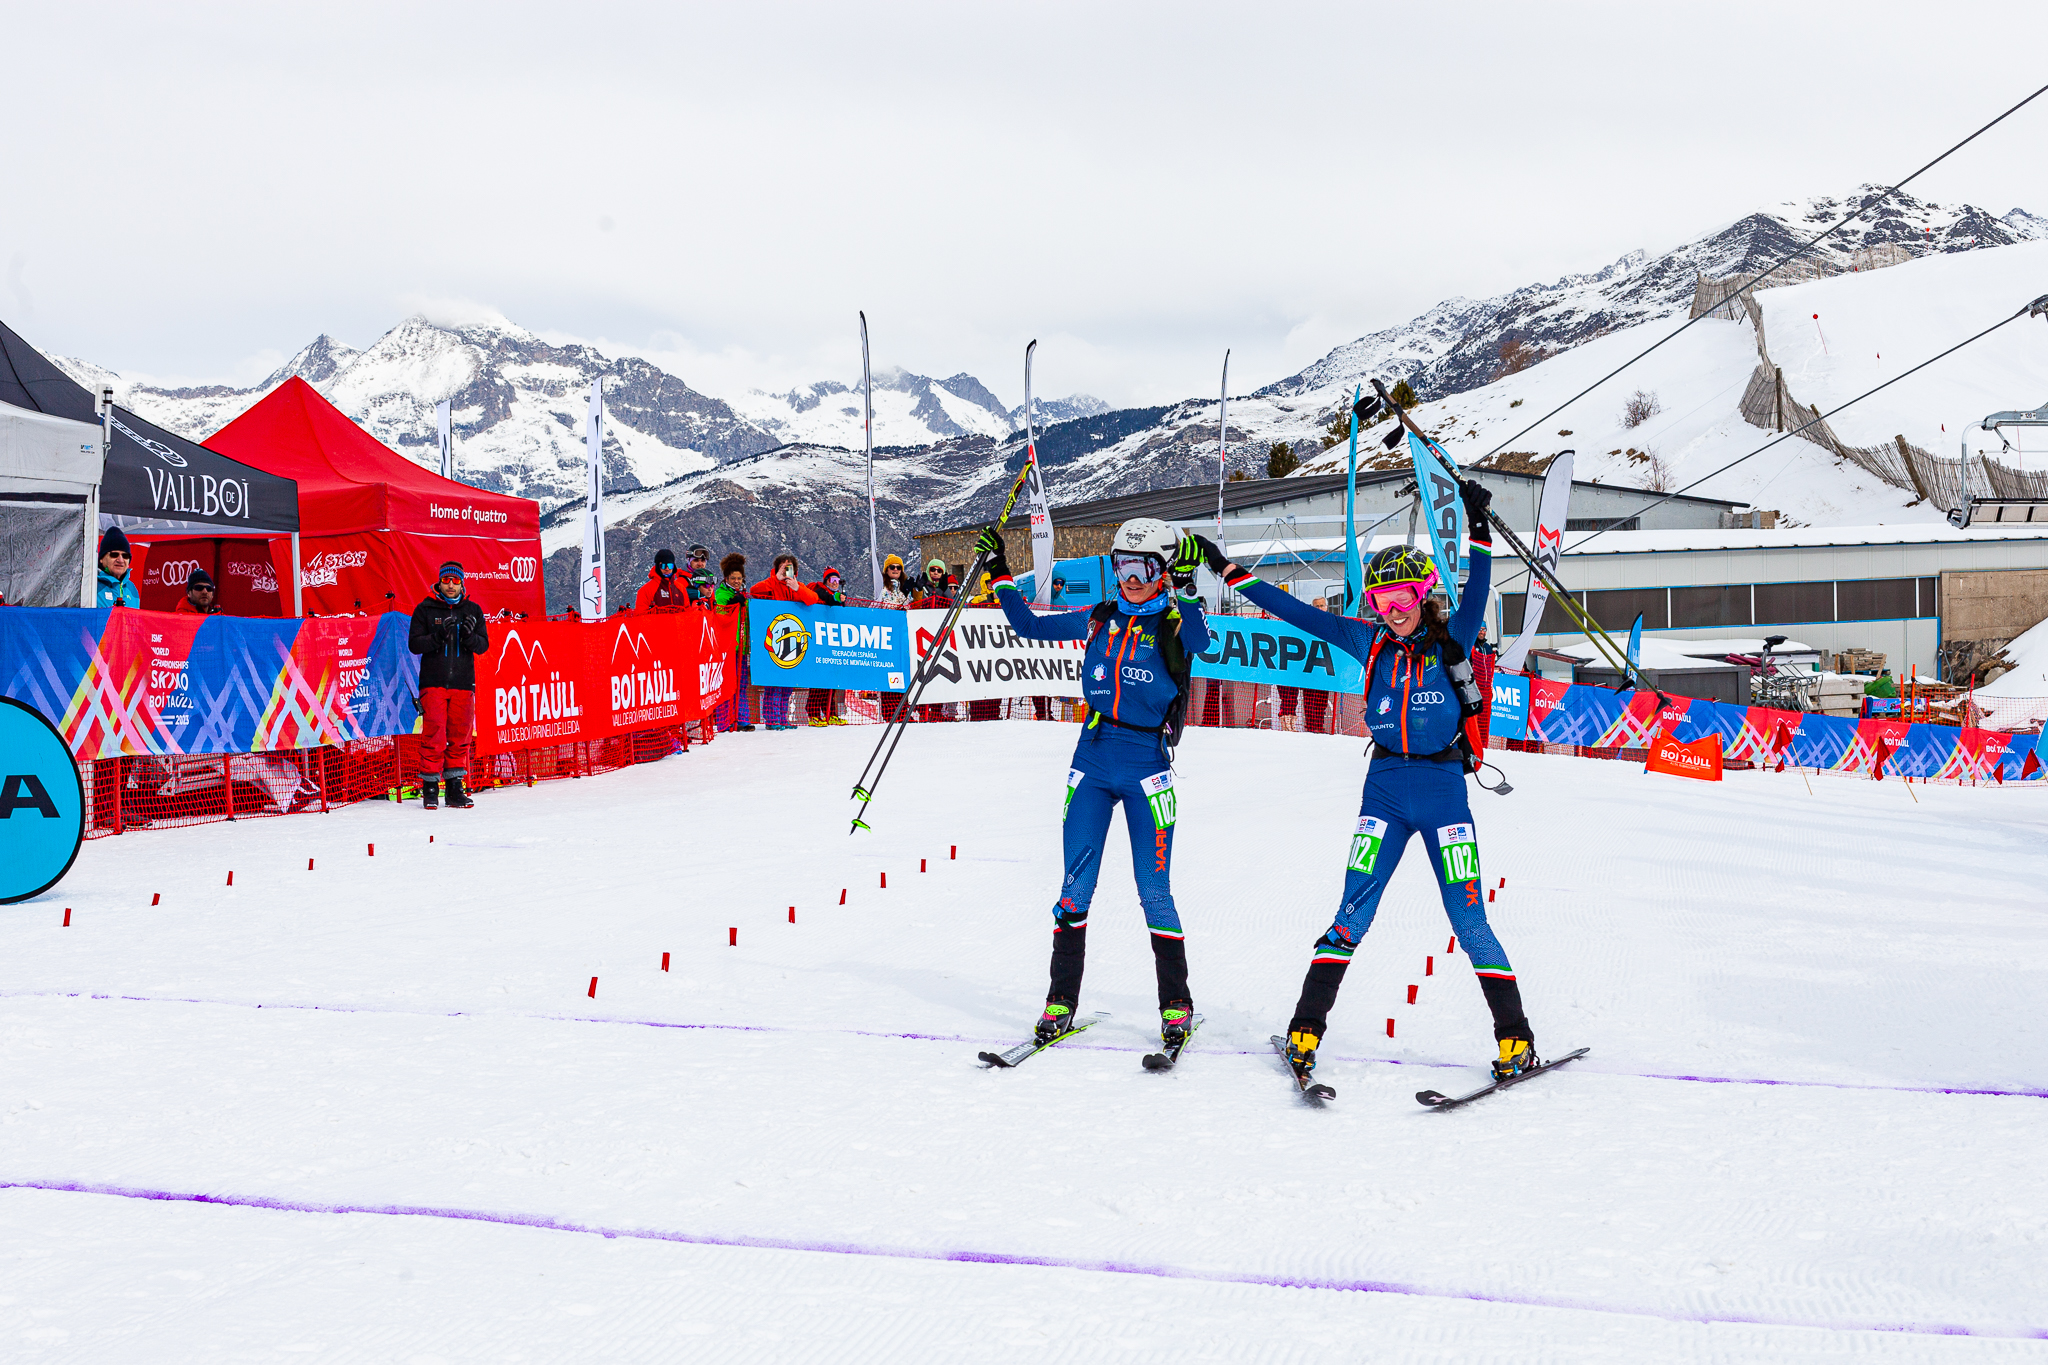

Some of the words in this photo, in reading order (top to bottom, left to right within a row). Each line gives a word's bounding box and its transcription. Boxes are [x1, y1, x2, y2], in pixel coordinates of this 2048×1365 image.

[143, 466, 200, 514] VALL
[430, 503, 459, 520] Home
[461, 505, 472, 520] of
[473, 509, 508, 525] quattro
[498, 562, 510, 571] Audi
[464, 571, 479, 581] sprung
[150, 633, 164, 643] ISMF
[814, 621, 893, 650] FEDME
[150, 646, 170, 657] WORLD
[1197, 630, 1336, 677] CARPA
[966, 658, 1083, 683] WORKWEA
[611, 664, 636, 711] BOÍ
[637, 659, 677, 707] TAÜLL
[149, 692, 166, 708] BOÍ
[495, 674, 527, 727] BOÍ
[529, 671, 580, 720] TAÜLL
[1535, 698, 1547, 709] BOÍ
[1547, 700, 1566, 712] TAÜLL
[174, 714, 190, 726] 2023
[1662, 710, 1675, 721] BOÍ
[1675, 713, 1692, 724] TAÜLL
[1369, 723, 1395, 731] SUUNTO
[496, 728, 512, 744] VALL
[511, 727, 521, 743] DE
[1895, 737, 1910, 748] TAÜLL
[1349, 835, 1376, 873] 02.1
